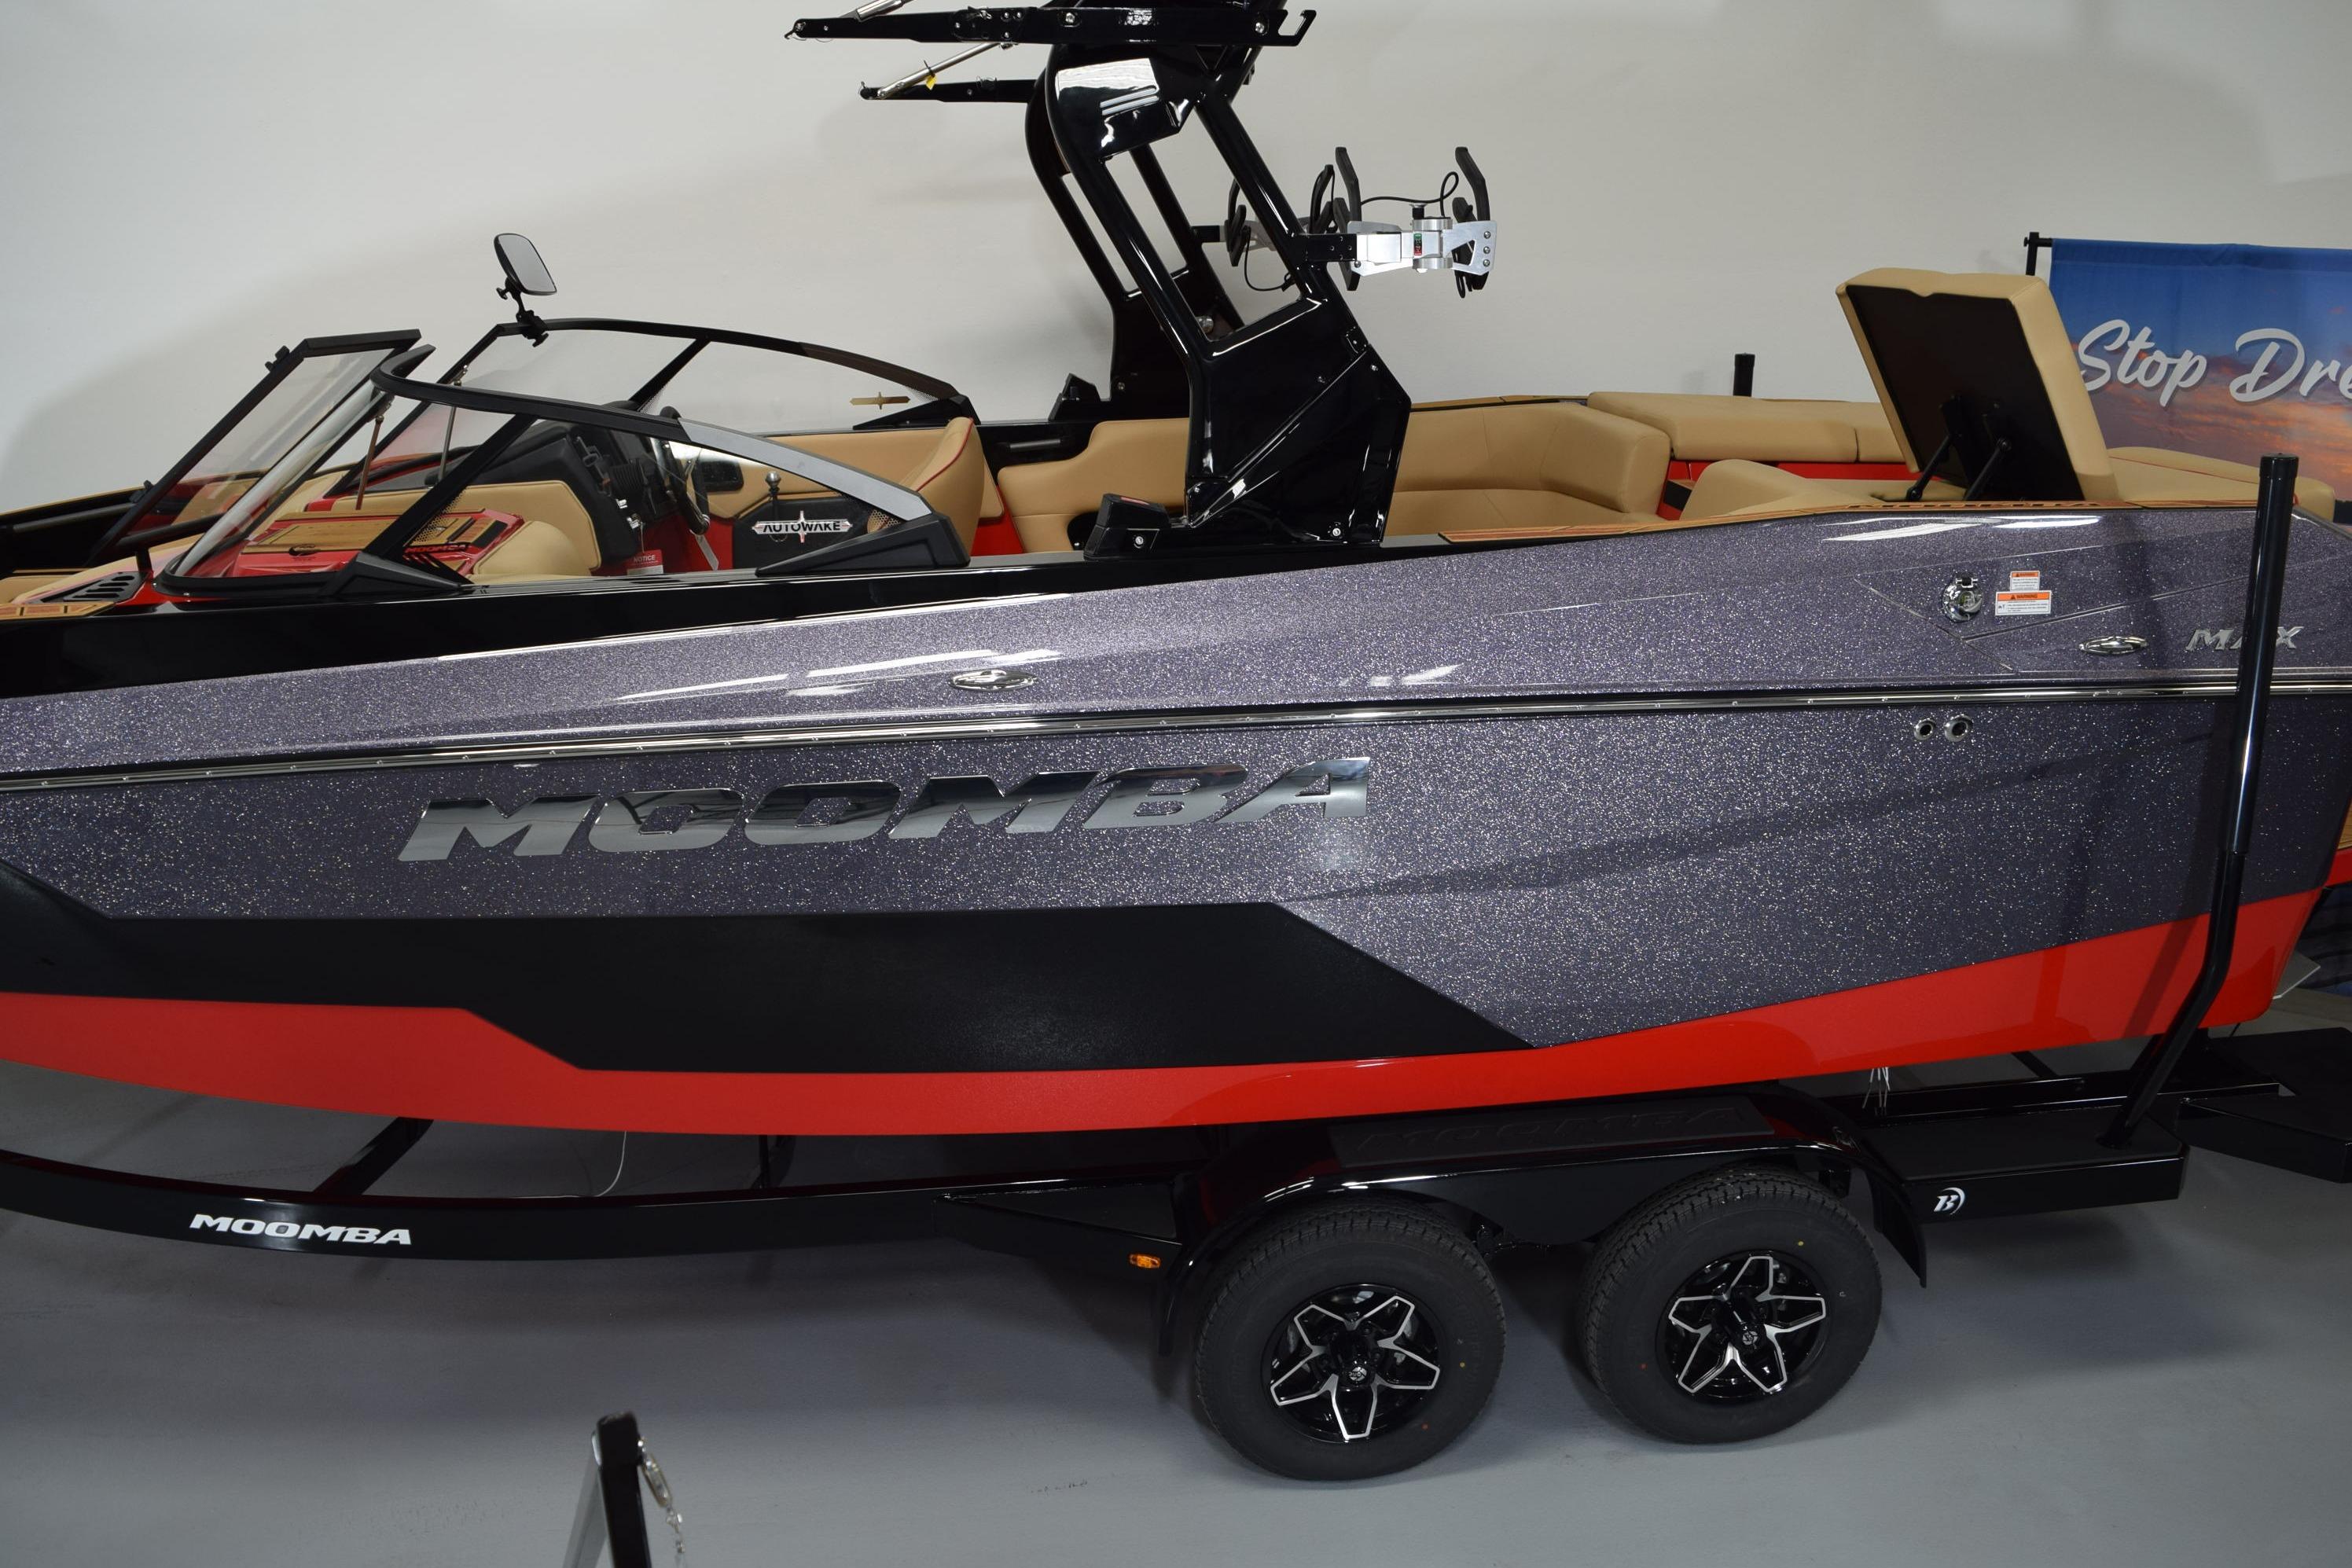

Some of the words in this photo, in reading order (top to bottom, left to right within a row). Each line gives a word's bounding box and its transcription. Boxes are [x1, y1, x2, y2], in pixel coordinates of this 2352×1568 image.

[2077, 319, 2207, 407] Stop
[763, 521, 841, 534] AUTOWAKE
[634, 554, 656, 563] NOTICE
[2185, 626, 2305, 652] MX
[397, 756, 1372, 861] MOOMBA
[189, 1214, 412, 1245] MOOMBA
